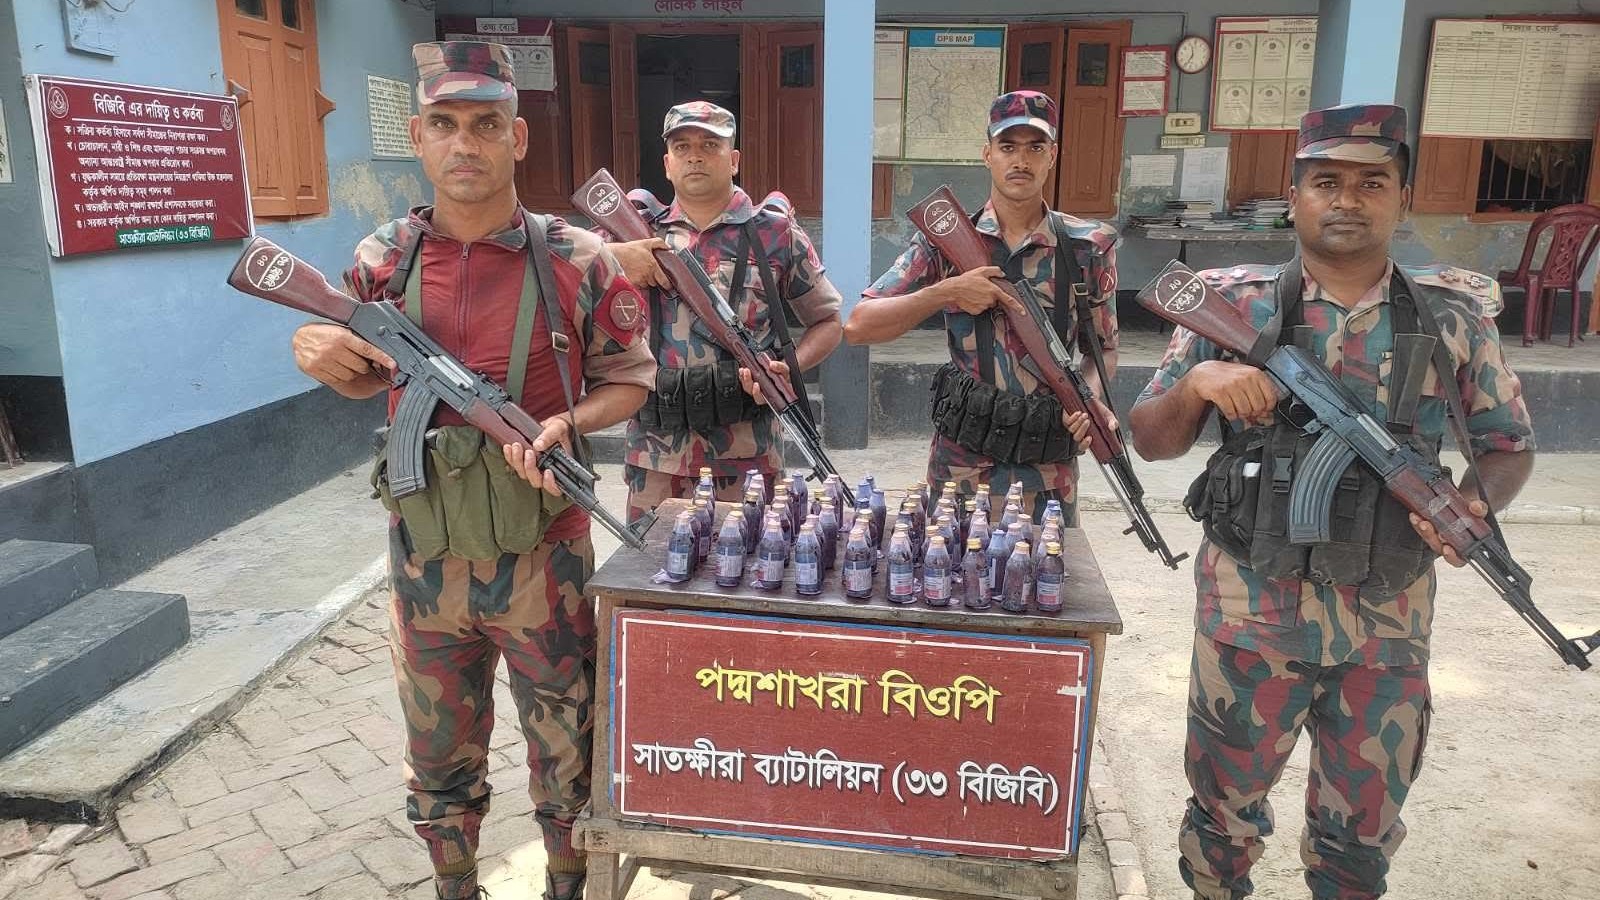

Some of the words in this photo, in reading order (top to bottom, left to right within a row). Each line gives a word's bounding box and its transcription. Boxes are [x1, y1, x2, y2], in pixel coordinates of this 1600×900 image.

[94, 92, 126, 116] বিজিবি
[129, 102, 142, 117] এর
[144, 100, 170, 122] দায়িত্ব
[173, 108, 180, 120] ও
[181, 104, 204, 122] কর্তব্য
[696, 664, 869, 714] পদ্মশাখরা
[876, 669, 1002, 724] বিওপি
[632, 737, 746, 782] সাতক্ষীরা
[751, 746, 885, 794] ব্যাটালিয়ন
[892, 760, 948, 803] (৩৩
[956, 760, 1059, 816] বিজিবি)
